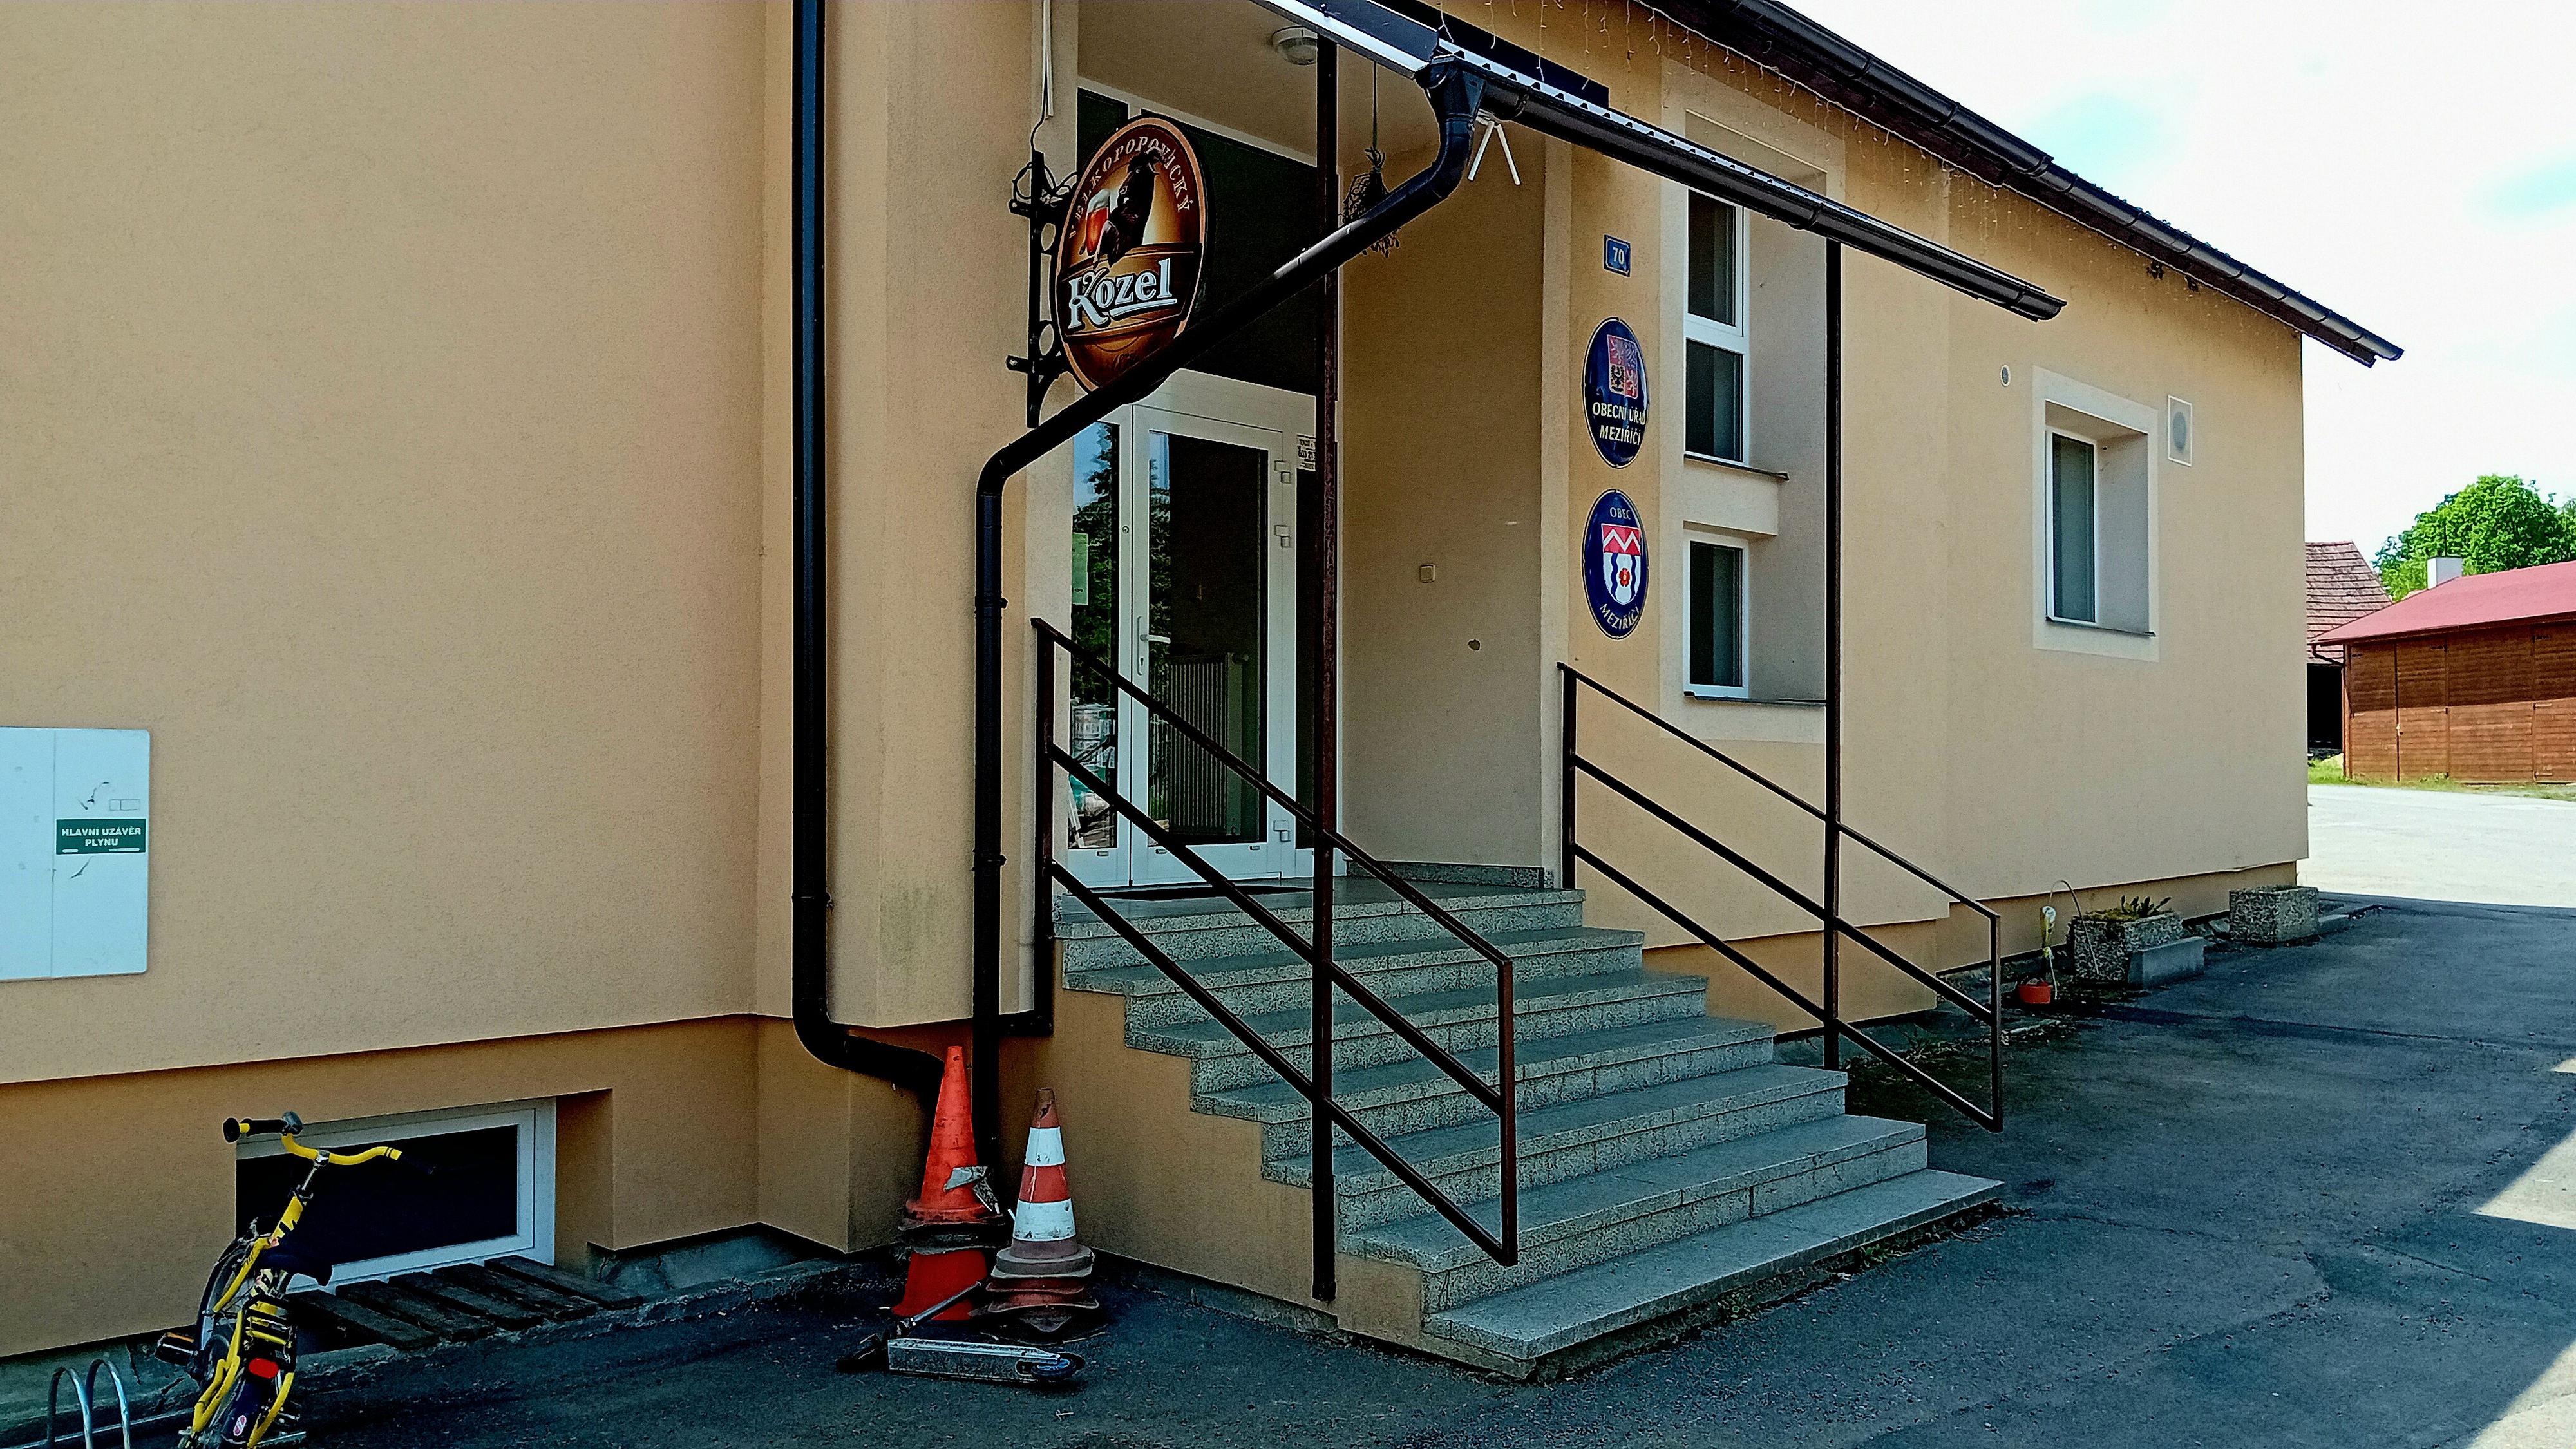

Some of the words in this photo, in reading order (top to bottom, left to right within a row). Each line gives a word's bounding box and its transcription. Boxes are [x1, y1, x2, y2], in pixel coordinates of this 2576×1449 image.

[1612, 247, 1625, 265] 70
[1068, 258, 1173, 329] Kozel
[1592, 402, 1626, 420] OBECNÍ
[1599, 424, 1642, 446] MEZIŘÍČÍ
[1610, 507, 1631, 520] OBEC
[61, 827, 99, 837] HLAVNÍ
